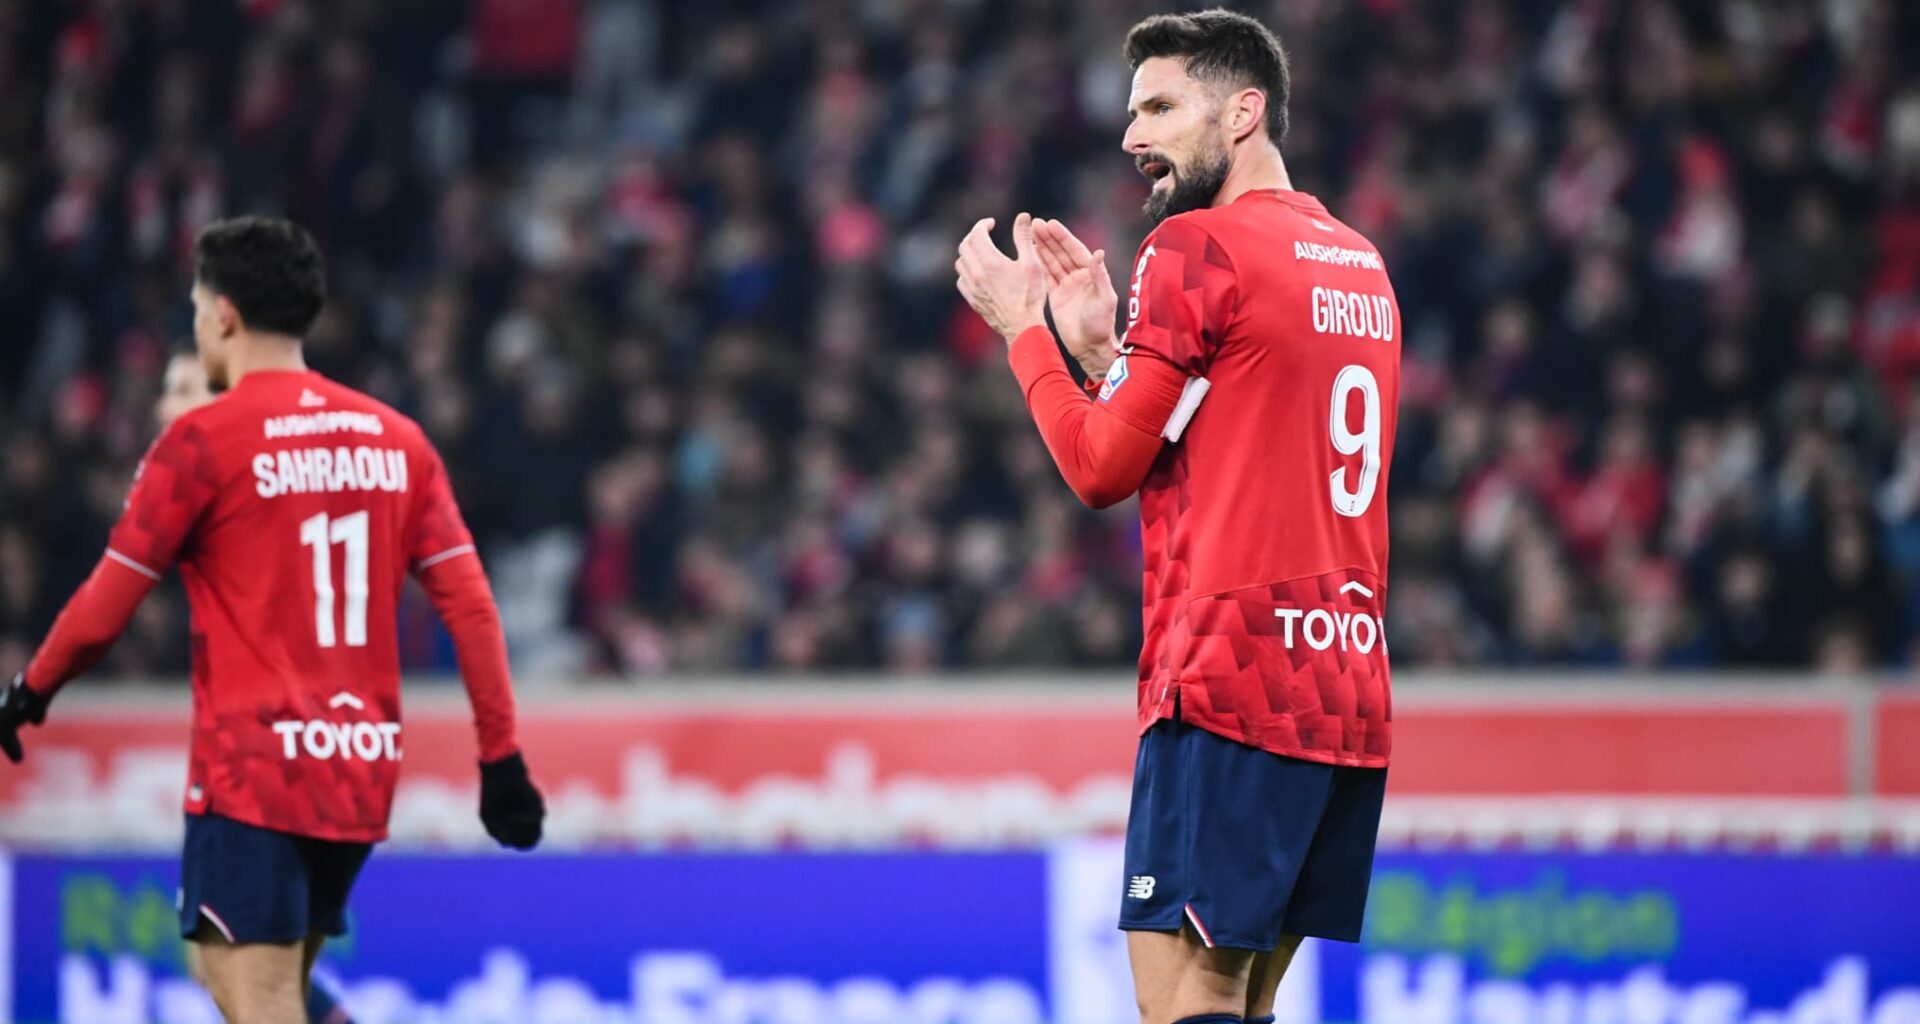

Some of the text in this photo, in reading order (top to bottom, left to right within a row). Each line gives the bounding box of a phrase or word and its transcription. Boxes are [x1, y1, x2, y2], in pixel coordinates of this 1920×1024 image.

[1312, 286, 1393, 342] GIROUD
[1330, 365, 1380, 517] 9
[252, 446, 408, 498] SAHRAOUI
[301, 510, 368, 648] 11
[272, 719, 403, 761] TOYOT
